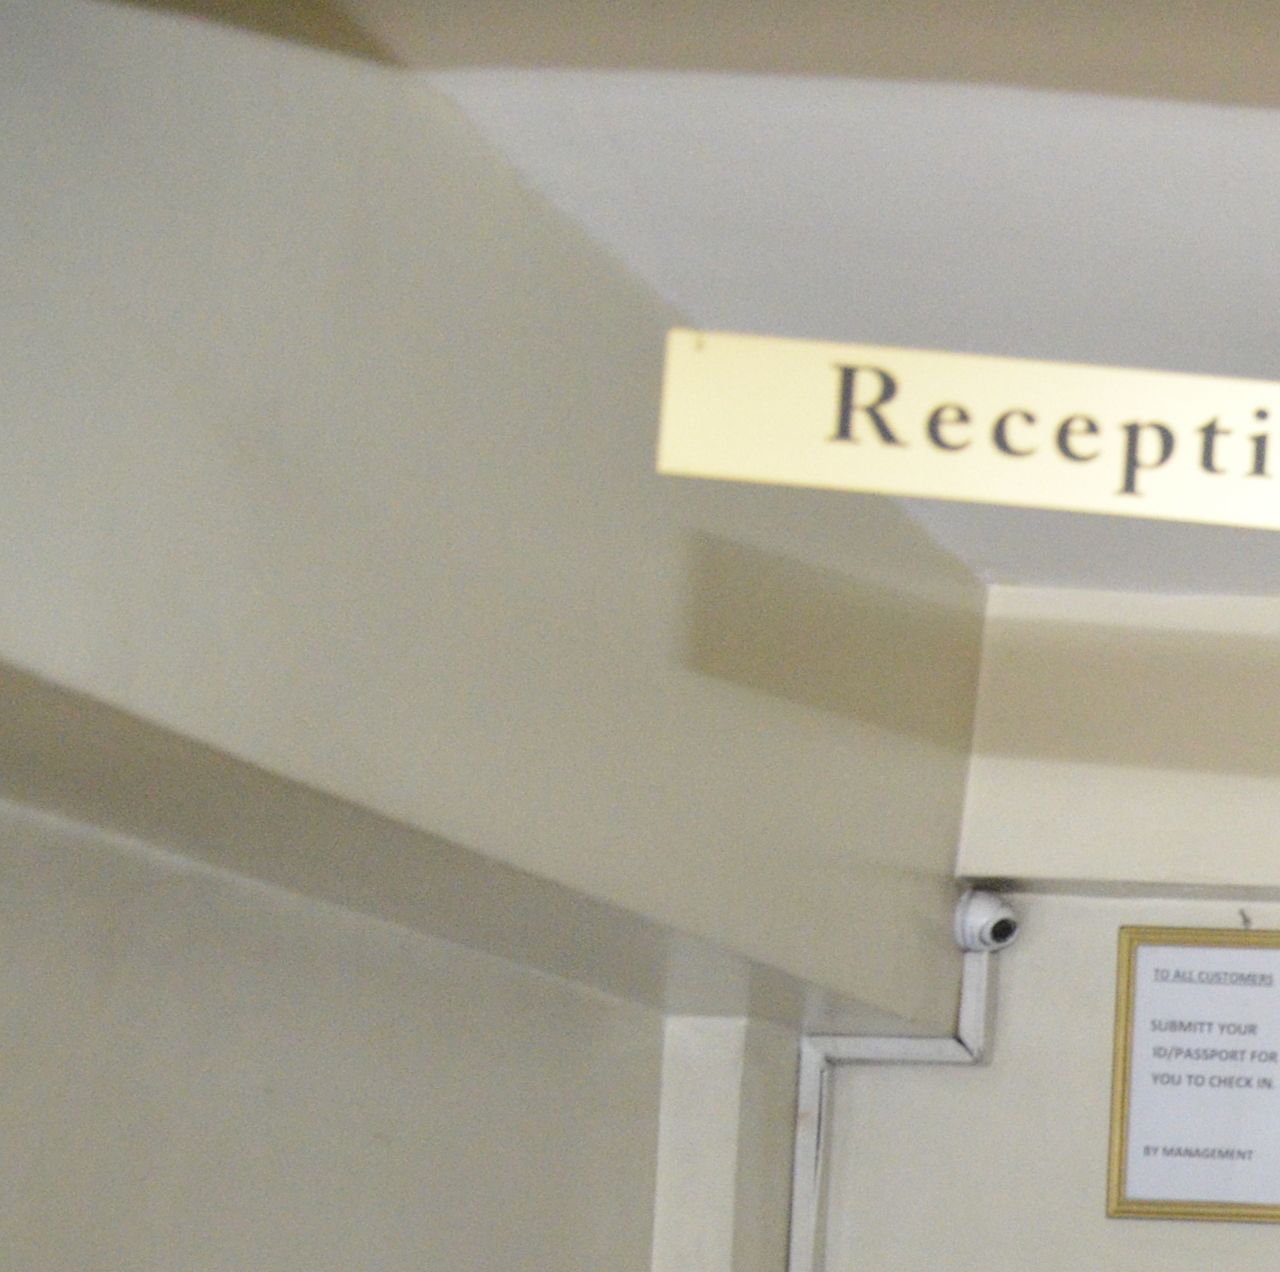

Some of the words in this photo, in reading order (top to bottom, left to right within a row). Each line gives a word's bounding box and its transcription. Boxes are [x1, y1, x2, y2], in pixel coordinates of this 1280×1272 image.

[1153, 968, 1171, 982] TO
[1173, 969, 1195, 983] ALL
[1198, 970, 1274, 987] CUSTOMERS
[1151, 1019, 1213, 1035] SUBMITT
[1218, 1022, 1258, 1036] YOUR
[1152, 1047, 1246, 1063] ID/PASSPORT
[1251, 1050, 1278, 1064] FOR
[1152, 1073, 1181, 1086] YOU
[1187, 1074, 1204, 1087] TO
[1209, 1075, 1252, 1089] CHECK
[1143, 1146, 1158, 1158] BY
[1162, 1146, 1253, 1161] MANAGEMENT
